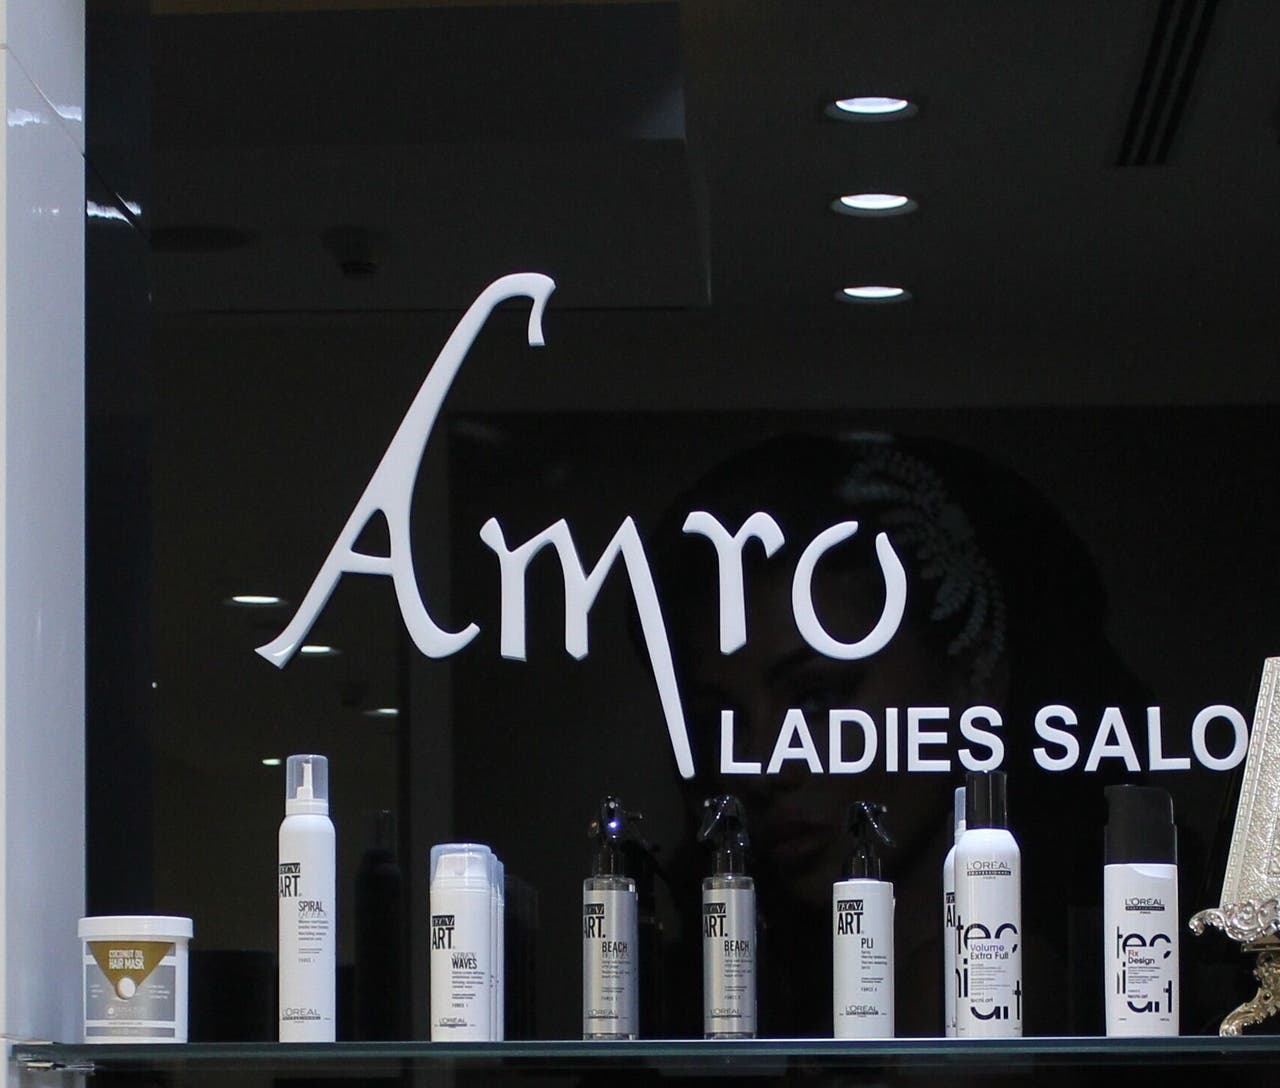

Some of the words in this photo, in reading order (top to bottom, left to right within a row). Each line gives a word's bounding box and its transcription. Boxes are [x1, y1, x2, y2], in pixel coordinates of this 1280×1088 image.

[255, 273, 906, 777] Amro
[721, 706, 1004, 773] LADIES
[1033, 705, 1250, 771] SALO
[298, 901, 324, 911] SPIRAL
[837, 911, 864, 935] ART
[431, 927, 455, 950] ART
[602, 941, 628, 953] BEACH
[724, 940, 750, 952] BEACH
[970, 943, 1005, 952] Volume
[970, 952, 992, 960] Extra
[995, 952, 1009, 960] Full
[1128, 957, 1155, 966] Design
[109, 958, 124, 970] HAIR
[125, 958, 145, 970] MASK
[452, 958, 478, 969] WAVES
